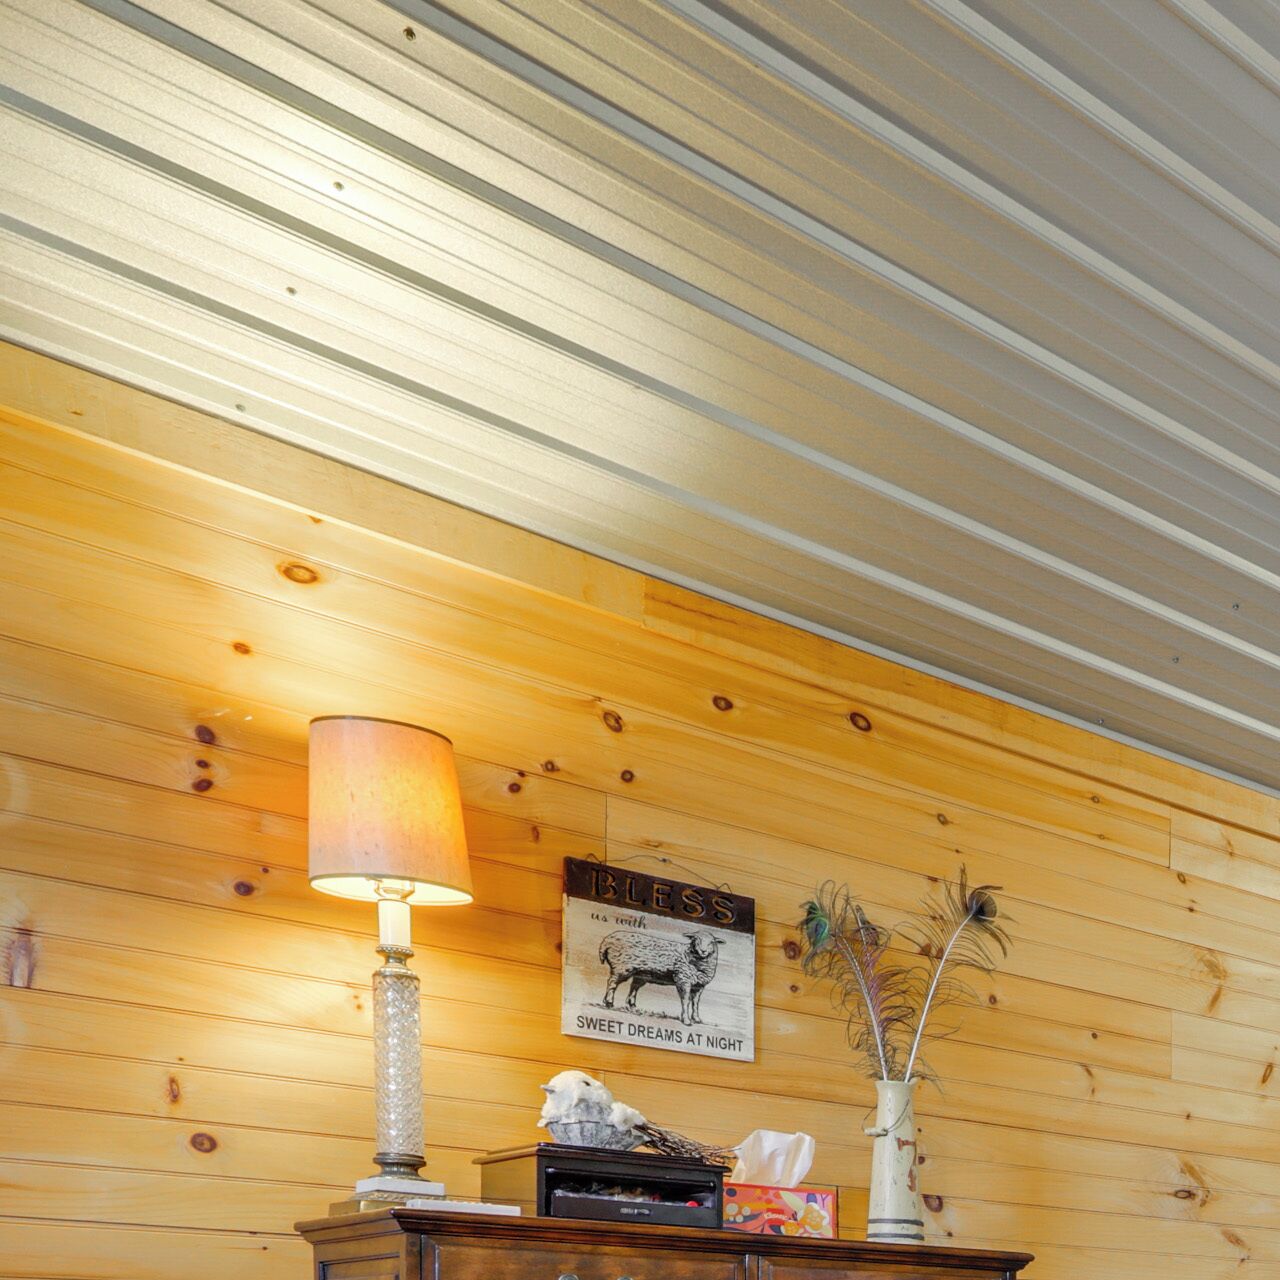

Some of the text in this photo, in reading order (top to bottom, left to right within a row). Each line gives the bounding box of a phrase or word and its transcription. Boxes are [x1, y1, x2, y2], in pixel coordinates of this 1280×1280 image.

[591, 867, 736, 924] BLESS
[591, 911, 647, 930] us with
[576, 1015, 744, 1053] SWEET DREAMS AT NIGHT
